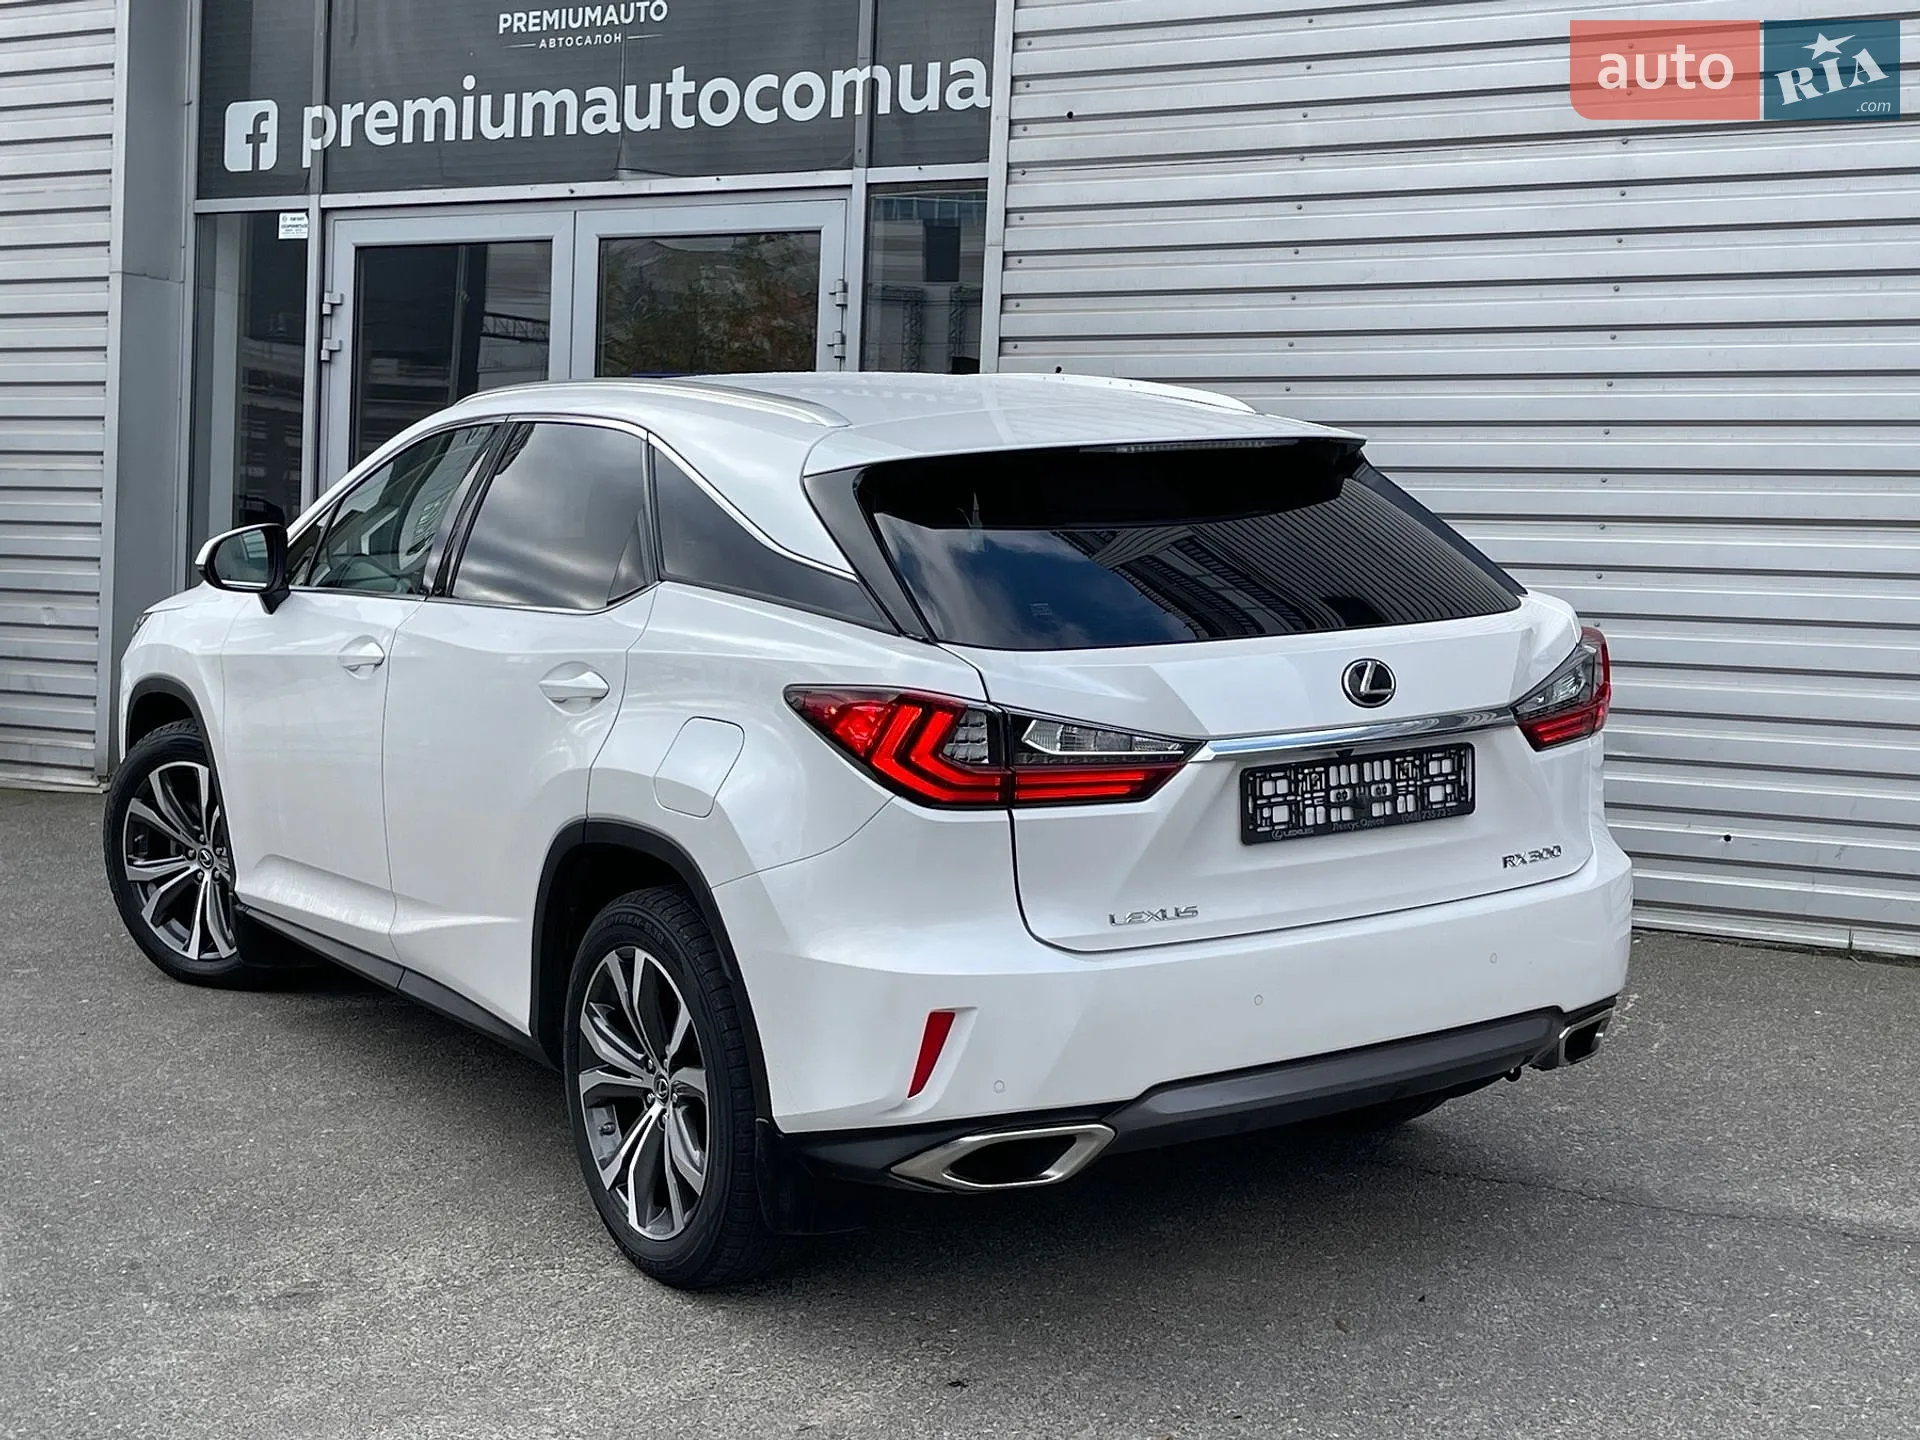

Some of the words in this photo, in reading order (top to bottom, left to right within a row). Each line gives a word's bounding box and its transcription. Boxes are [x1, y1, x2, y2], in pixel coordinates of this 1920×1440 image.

[498, 0, 668, 34] PREMIUMAUTO
[538, 33, 622, 49] АВТОСАЛОН
[302, 56, 991, 169] premiumautocomua
[1502, 851, 1527, 869] RX
[1528, 845, 1562, 864] 300
[1108, 905, 1199, 926] LEXUS
